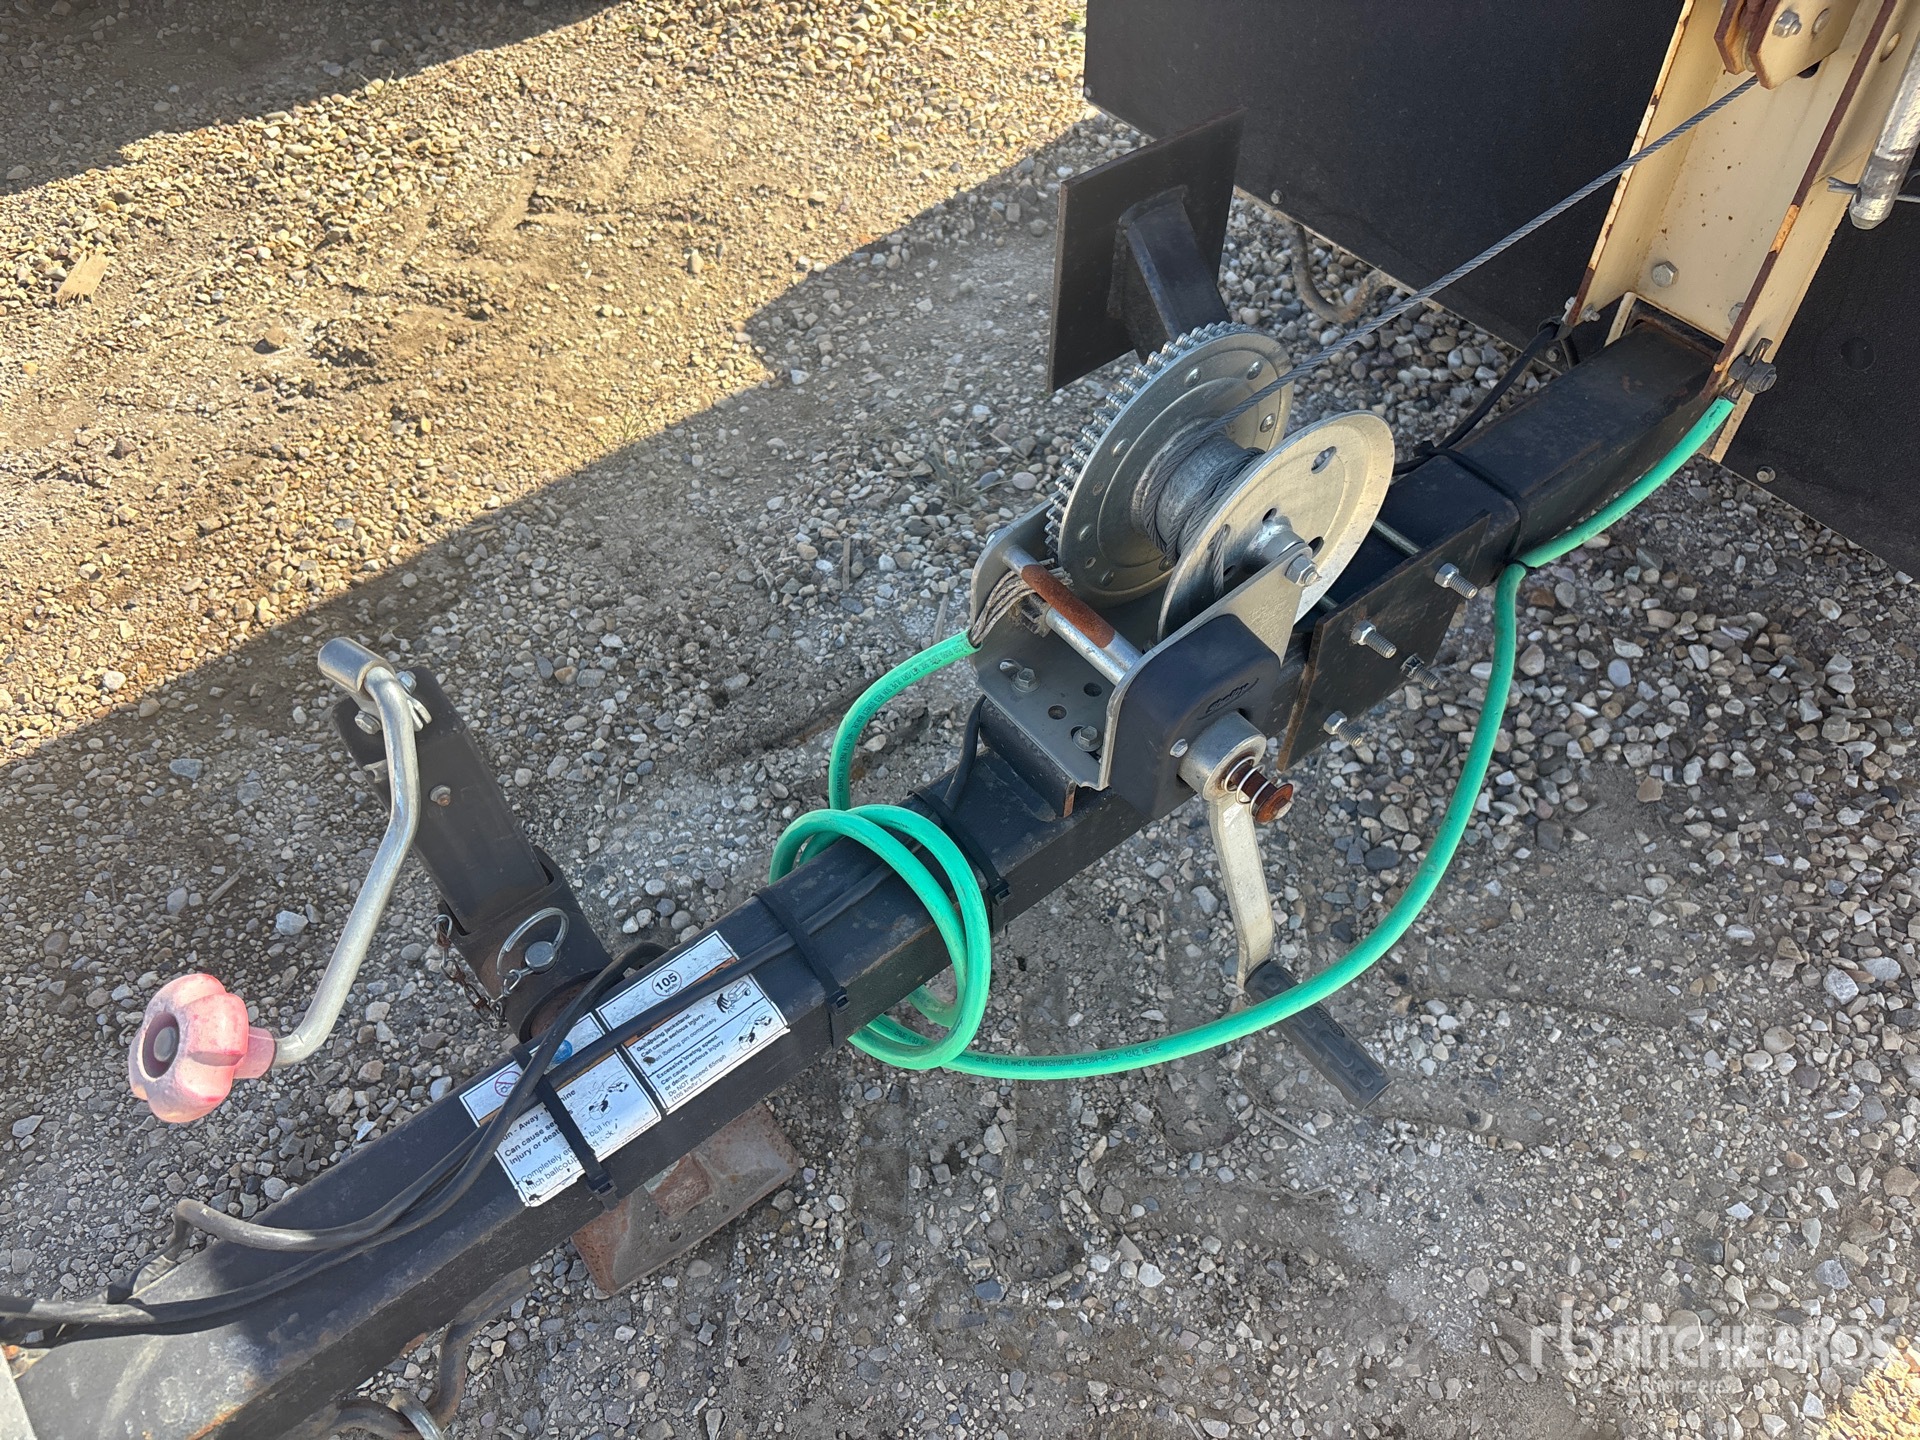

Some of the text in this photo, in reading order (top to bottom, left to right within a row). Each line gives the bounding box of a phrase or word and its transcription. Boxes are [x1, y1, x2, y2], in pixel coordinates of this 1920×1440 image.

[655, 972, 678, 992] 105
[652, 1038, 668, 1050] cause
[669, 1024, 688, 1039] serious
[656, 1060, 683, 1080] Excessive
[683, 1046, 702, 1061] towing
[661, 1075, 672, 1085] Can
[672, 1064, 688, 1077] cause
[689, 1051, 708, 1066] serious
[677, 1080, 690, 1091] NOT
[690, 1068, 709, 1082] exceed
[709, 1054, 726, 1068] 65mph
[518, 1114, 539, 1130] Away
[504, 1144, 521, 1157] Can
[521, 1129, 545, 1146] cause
[533, 1142, 542, 1150] or
[521, 1152, 563, 1182] Completely
